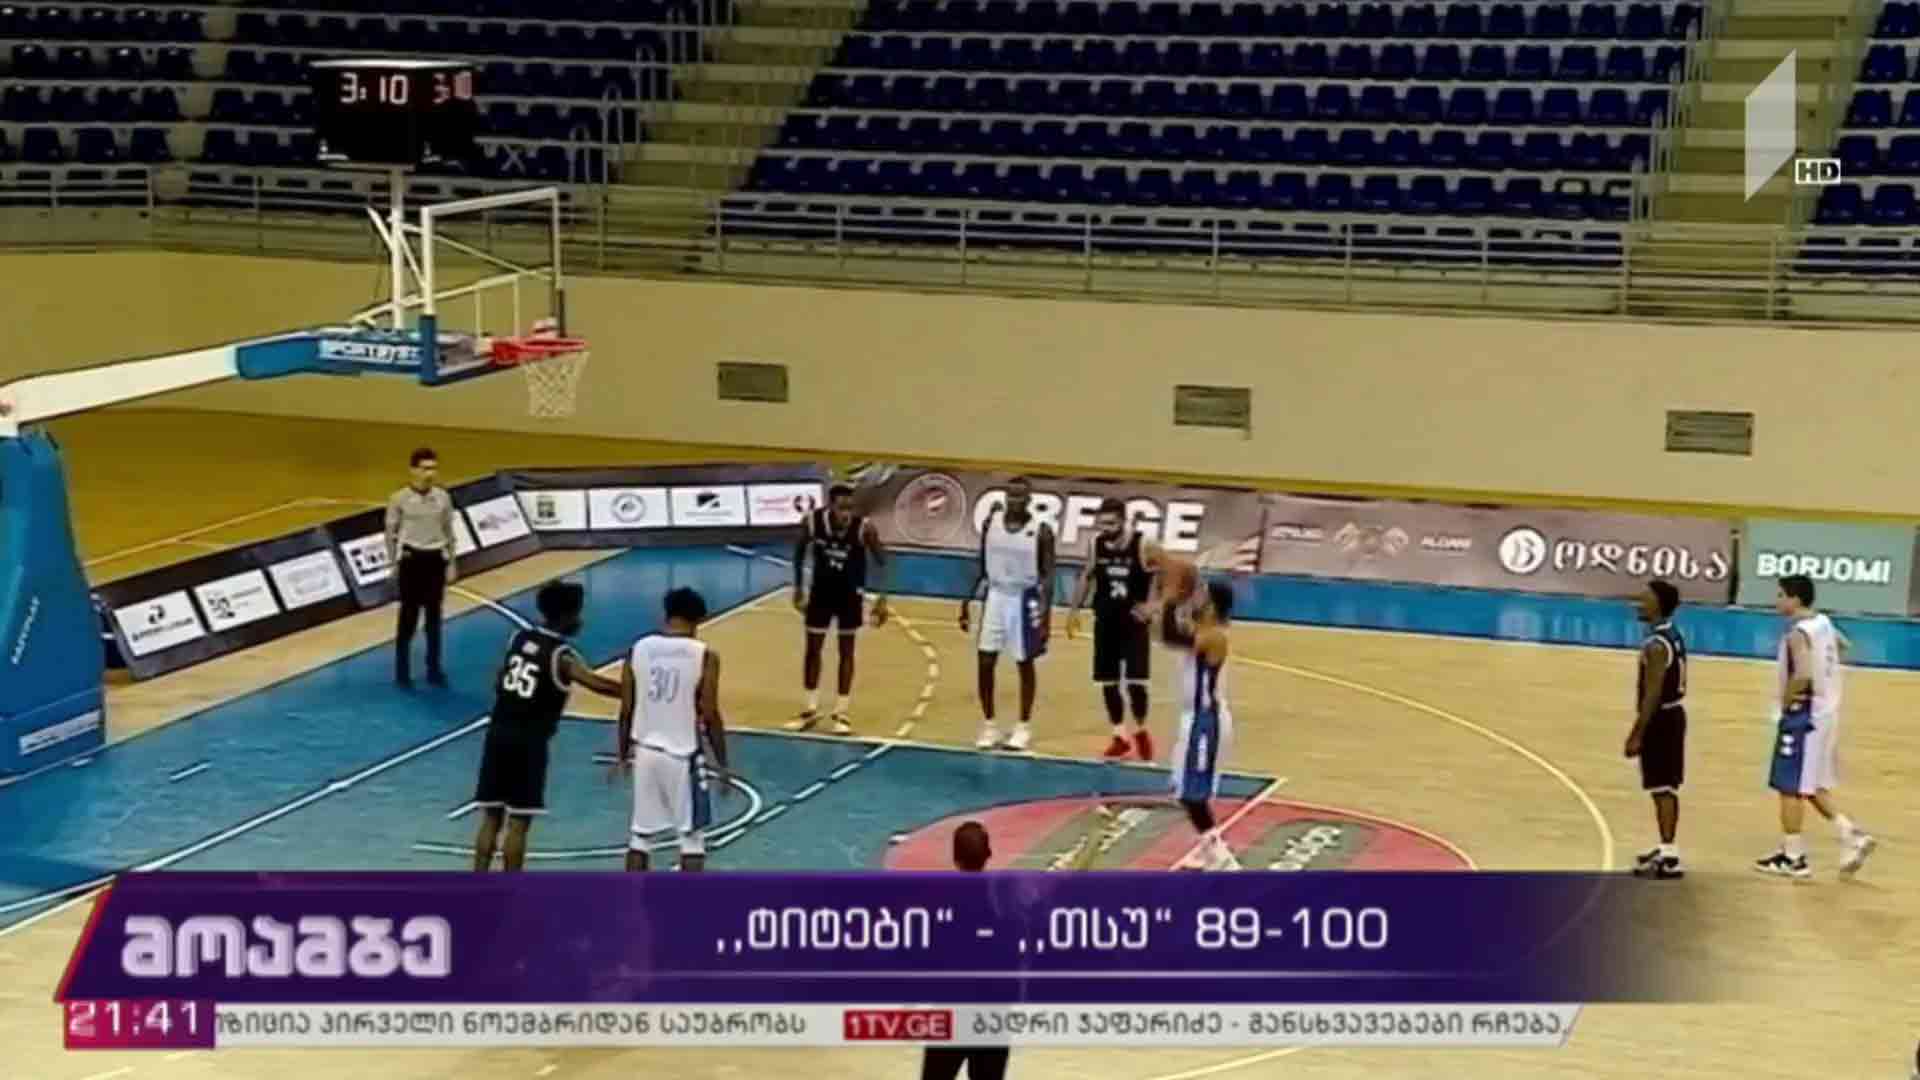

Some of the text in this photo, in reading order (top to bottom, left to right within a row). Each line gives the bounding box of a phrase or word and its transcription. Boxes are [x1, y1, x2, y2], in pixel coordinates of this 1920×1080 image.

[340, 71, 409, 105] 3:10
[1756, 552, 1891, 584] BORJOMI
[503, 654, 540, 698] 35
[648, 665, 681, 704] 30
